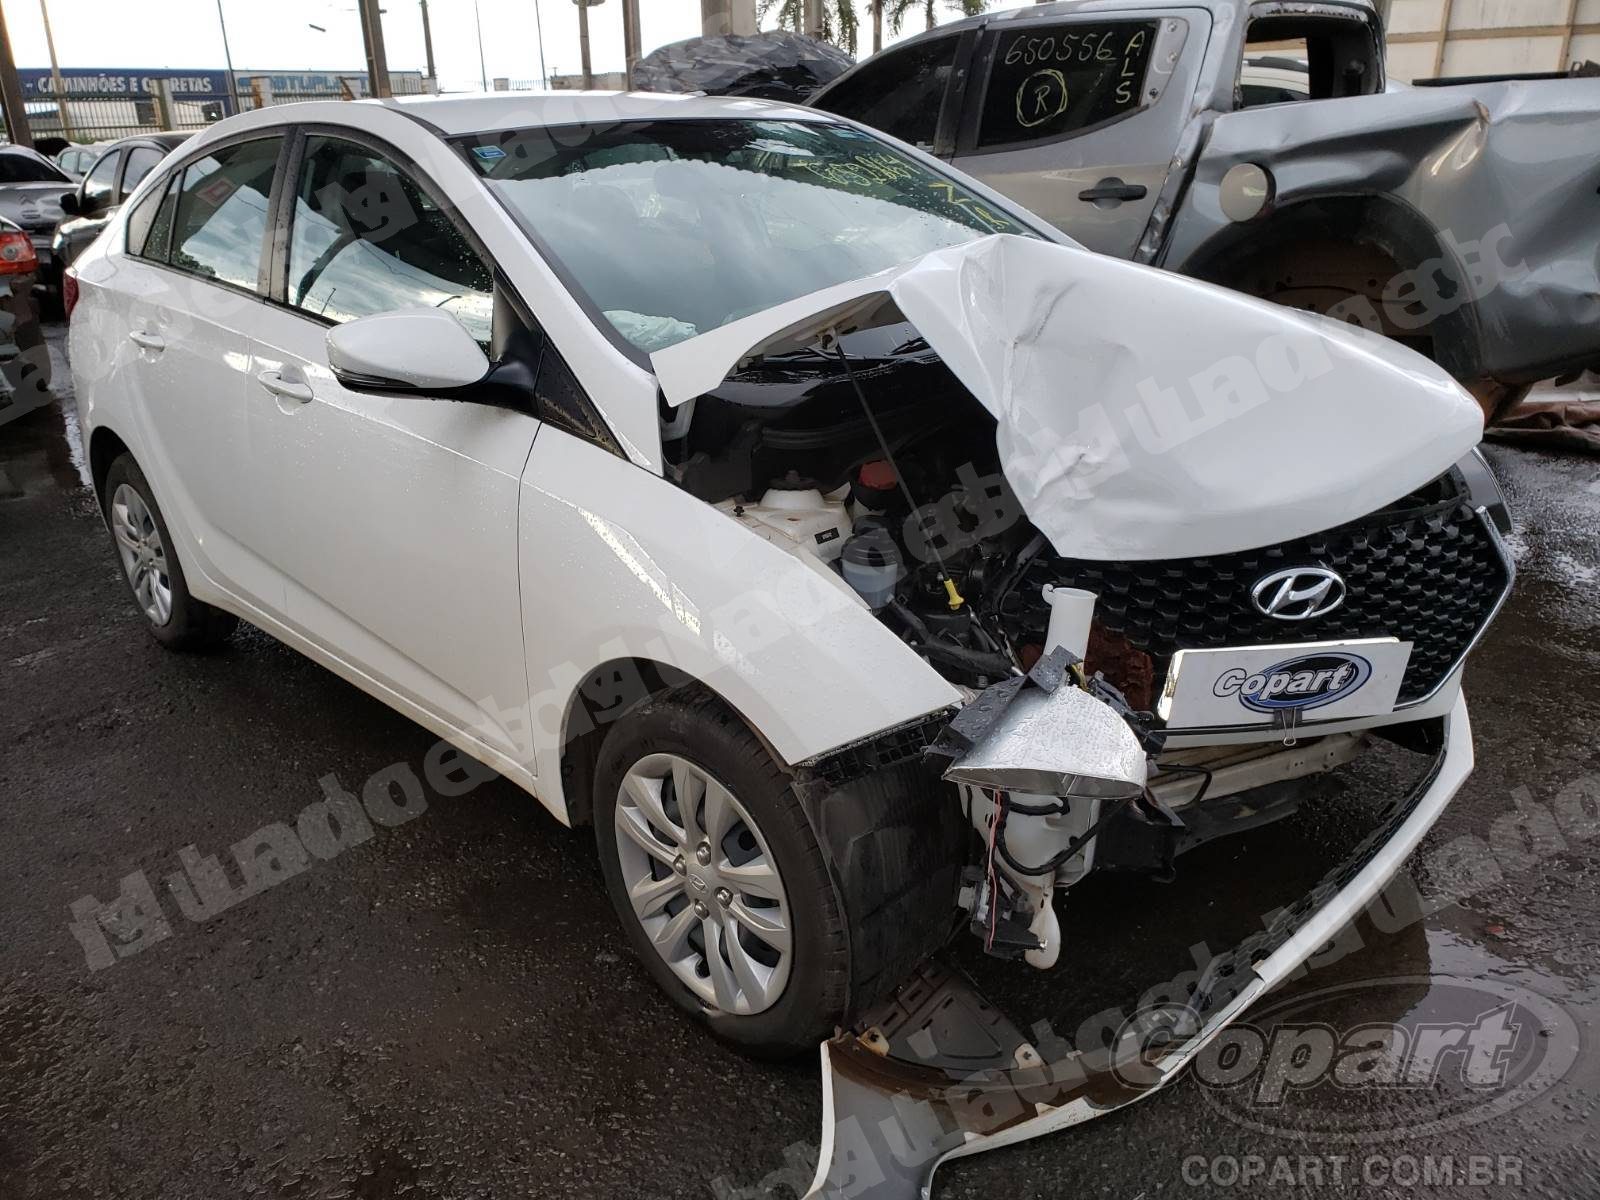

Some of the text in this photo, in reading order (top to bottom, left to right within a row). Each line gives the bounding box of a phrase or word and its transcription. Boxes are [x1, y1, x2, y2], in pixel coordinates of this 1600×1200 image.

[1005, 31, 1117, 65] 650556
[129, 77, 138, 92] E
[142, 77, 212, 93] CRETAS
[1213, 662, 1354, 701] Copart
